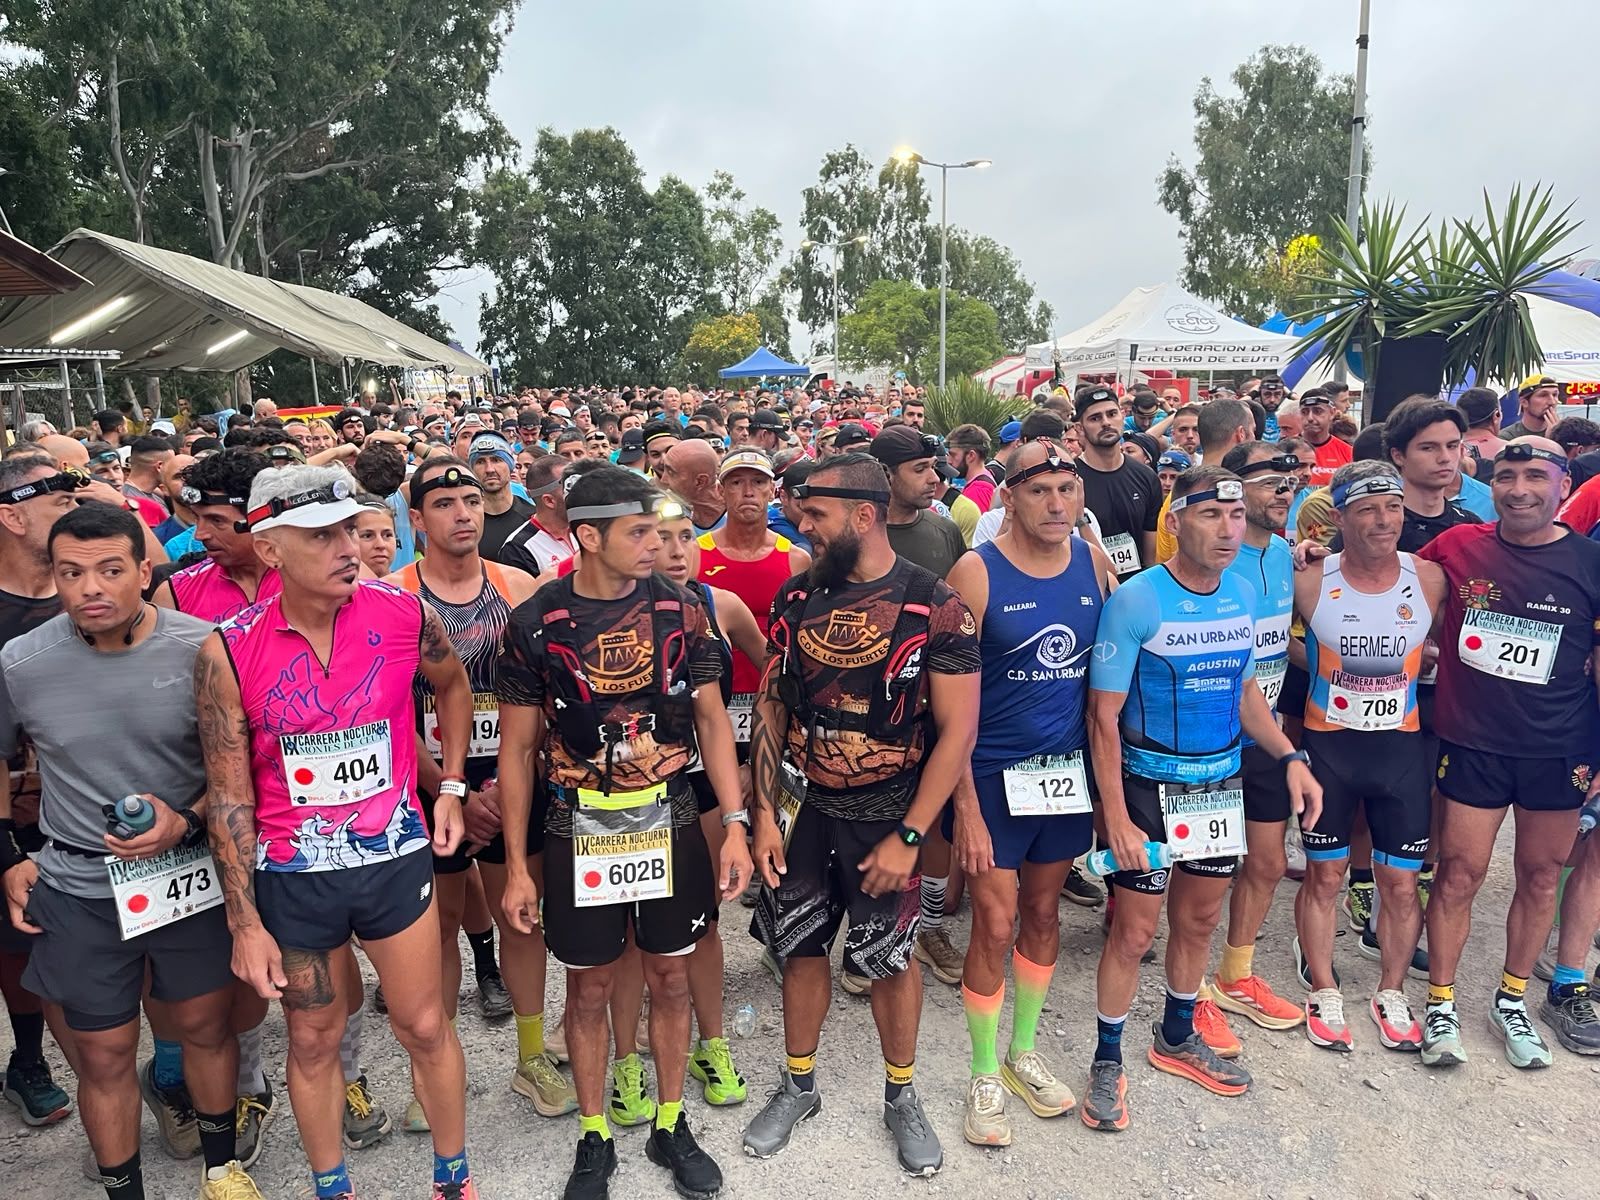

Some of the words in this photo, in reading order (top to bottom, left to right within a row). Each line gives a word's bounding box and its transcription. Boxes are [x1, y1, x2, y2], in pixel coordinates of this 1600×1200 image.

[1251, 344, 1271, 352] DE
[1138, 355, 1203, 363] CICLISMO
[1208, 355, 1227, 363] DE
[1232, 355, 1280, 363] CEUTA
[1111, 549, 1132, 564] 194
[1003, 602, 1037, 612] BALEARIA
[1526, 602, 1558, 613] RAMIX
[1559, 607, 1571, 615] 30
[1464, 608, 1481, 627] IX
[1479, 611, 1515, 627] CARRERA
[1517, 618, 1560, 635] NOCTURNA
[1479, 621, 1511, 634] MONTES
[1529, 630, 1558, 642] CEUTA
[1165, 633, 1197, 646] SAN
[1200, 626, 1251, 644] URBANO
[822, 654, 843, 665] LOS
[845, 642, 890, 665] FUERTES
[1340, 635, 1407, 658] BERMEJO
[1498, 642, 1540, 667] 201
[1007, 669, 1028, 681] C.D.
[1031, 670, 1054, 681] SAN
[1055, 666, 1087, 679] URBAN
[1186, 657, 1241, 673] AGUSTÍN
[602, 682, 626, 691] LOS
[1331, 669, 1344, 687] IX
[1342, 672, 1374, 687] CARRERA
[1375, 673, 1408, 686] NOCTURNA
[1262, 680, 1281, 700] 123
[1362, 698, 1398, 716] 708
[737, 713, 753, 729] 2
[281, 736, 300, 756] IX
[298, 735, 341, 748] CARRERA
[343, 720, 388, 741] NOCTURNA
[300, 744, 340, 755] MONTES
[344, 741, 354, 749] DE
[333, 753, 380, 784] 404
[1038, 777, 1076, 798] 122
[1167, 797, 1179, 814] IX
[1178, 794, 1209, 806] CARRERA
[1210, 790, 1242, 803] NOCTURNA
[1209, 818, 1228, 839] 91
[575, 836, 590, 856] IX
[590, 834, 627, 847] CARRERA
[629, 828, 669, 845] NOCTURNA
[590, 846, 626, 854] MONTES
[110, 860, 131, 886] IX
[130, 861, 172, 879] MONTES
[608, 857, 666, 886] 602B
[166, 867, 211, 901] 473
